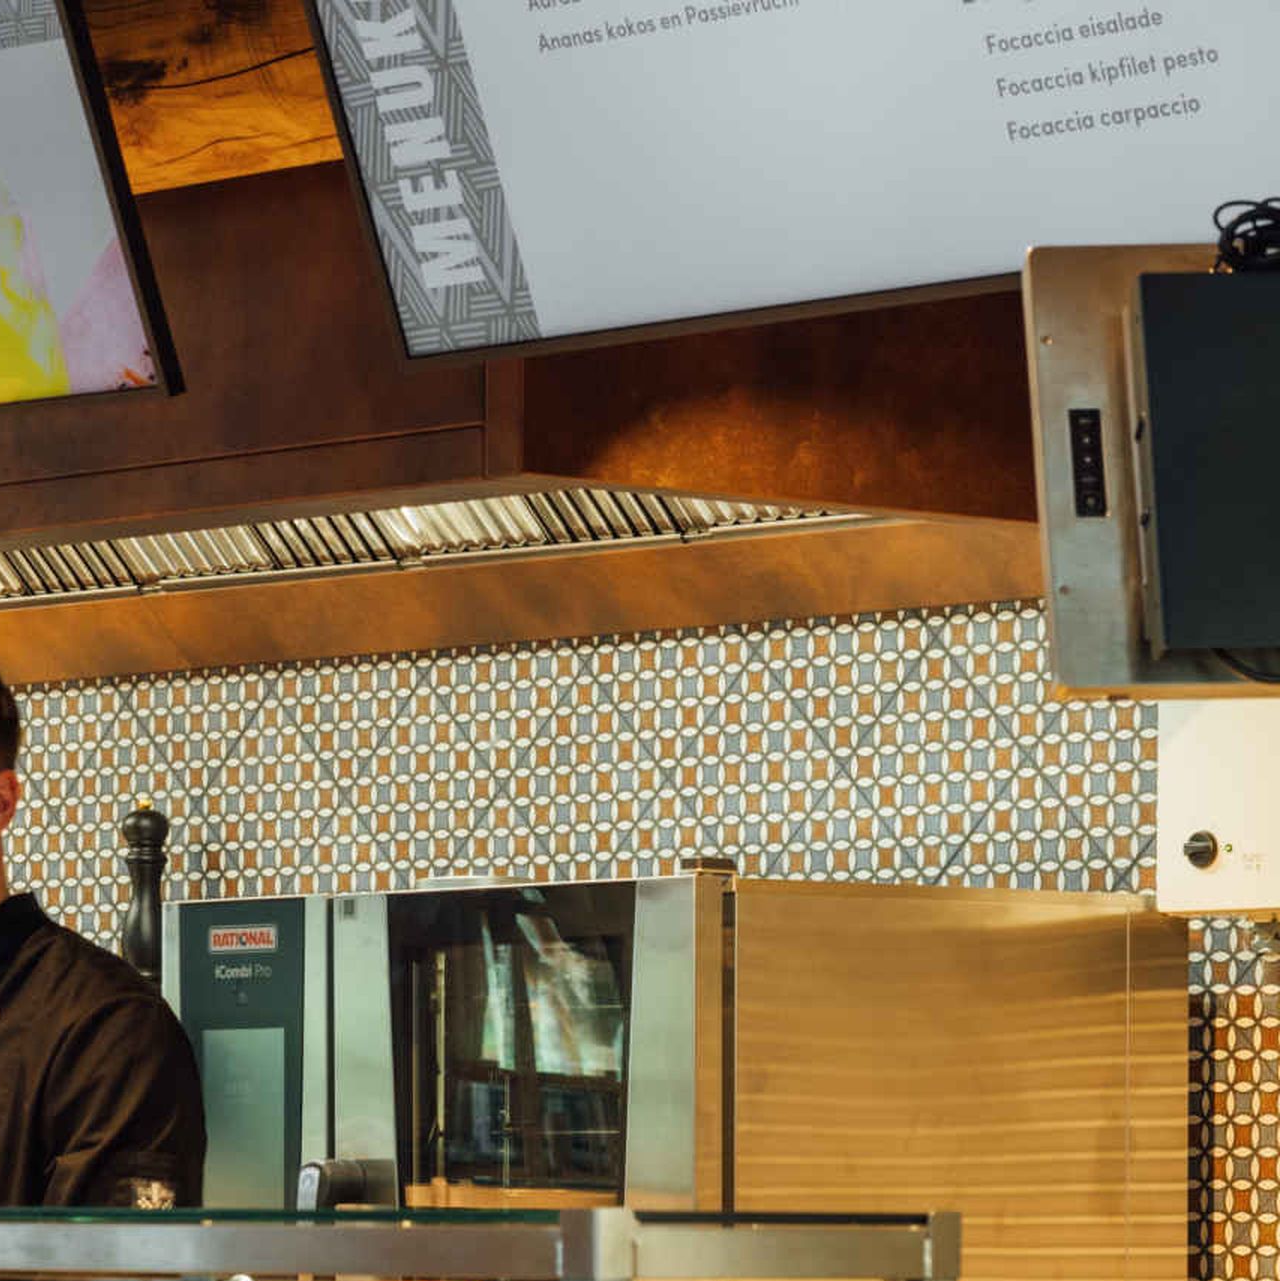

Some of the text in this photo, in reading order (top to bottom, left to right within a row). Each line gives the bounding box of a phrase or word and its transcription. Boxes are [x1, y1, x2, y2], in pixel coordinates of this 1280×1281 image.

[538, 24, 603, 53] Ananas
[605, 17, 656, 39] kokos
[659, 13, 682, 30] en
[985, 8, 1163, 54] Focaccia eisalade
[996, 46, 1219, 97] Focaccia kipfilet pesto
[1006, 93, 1202, 141] Focaccia carpaccio
[211, 928, 274, 948] RATIONAL
